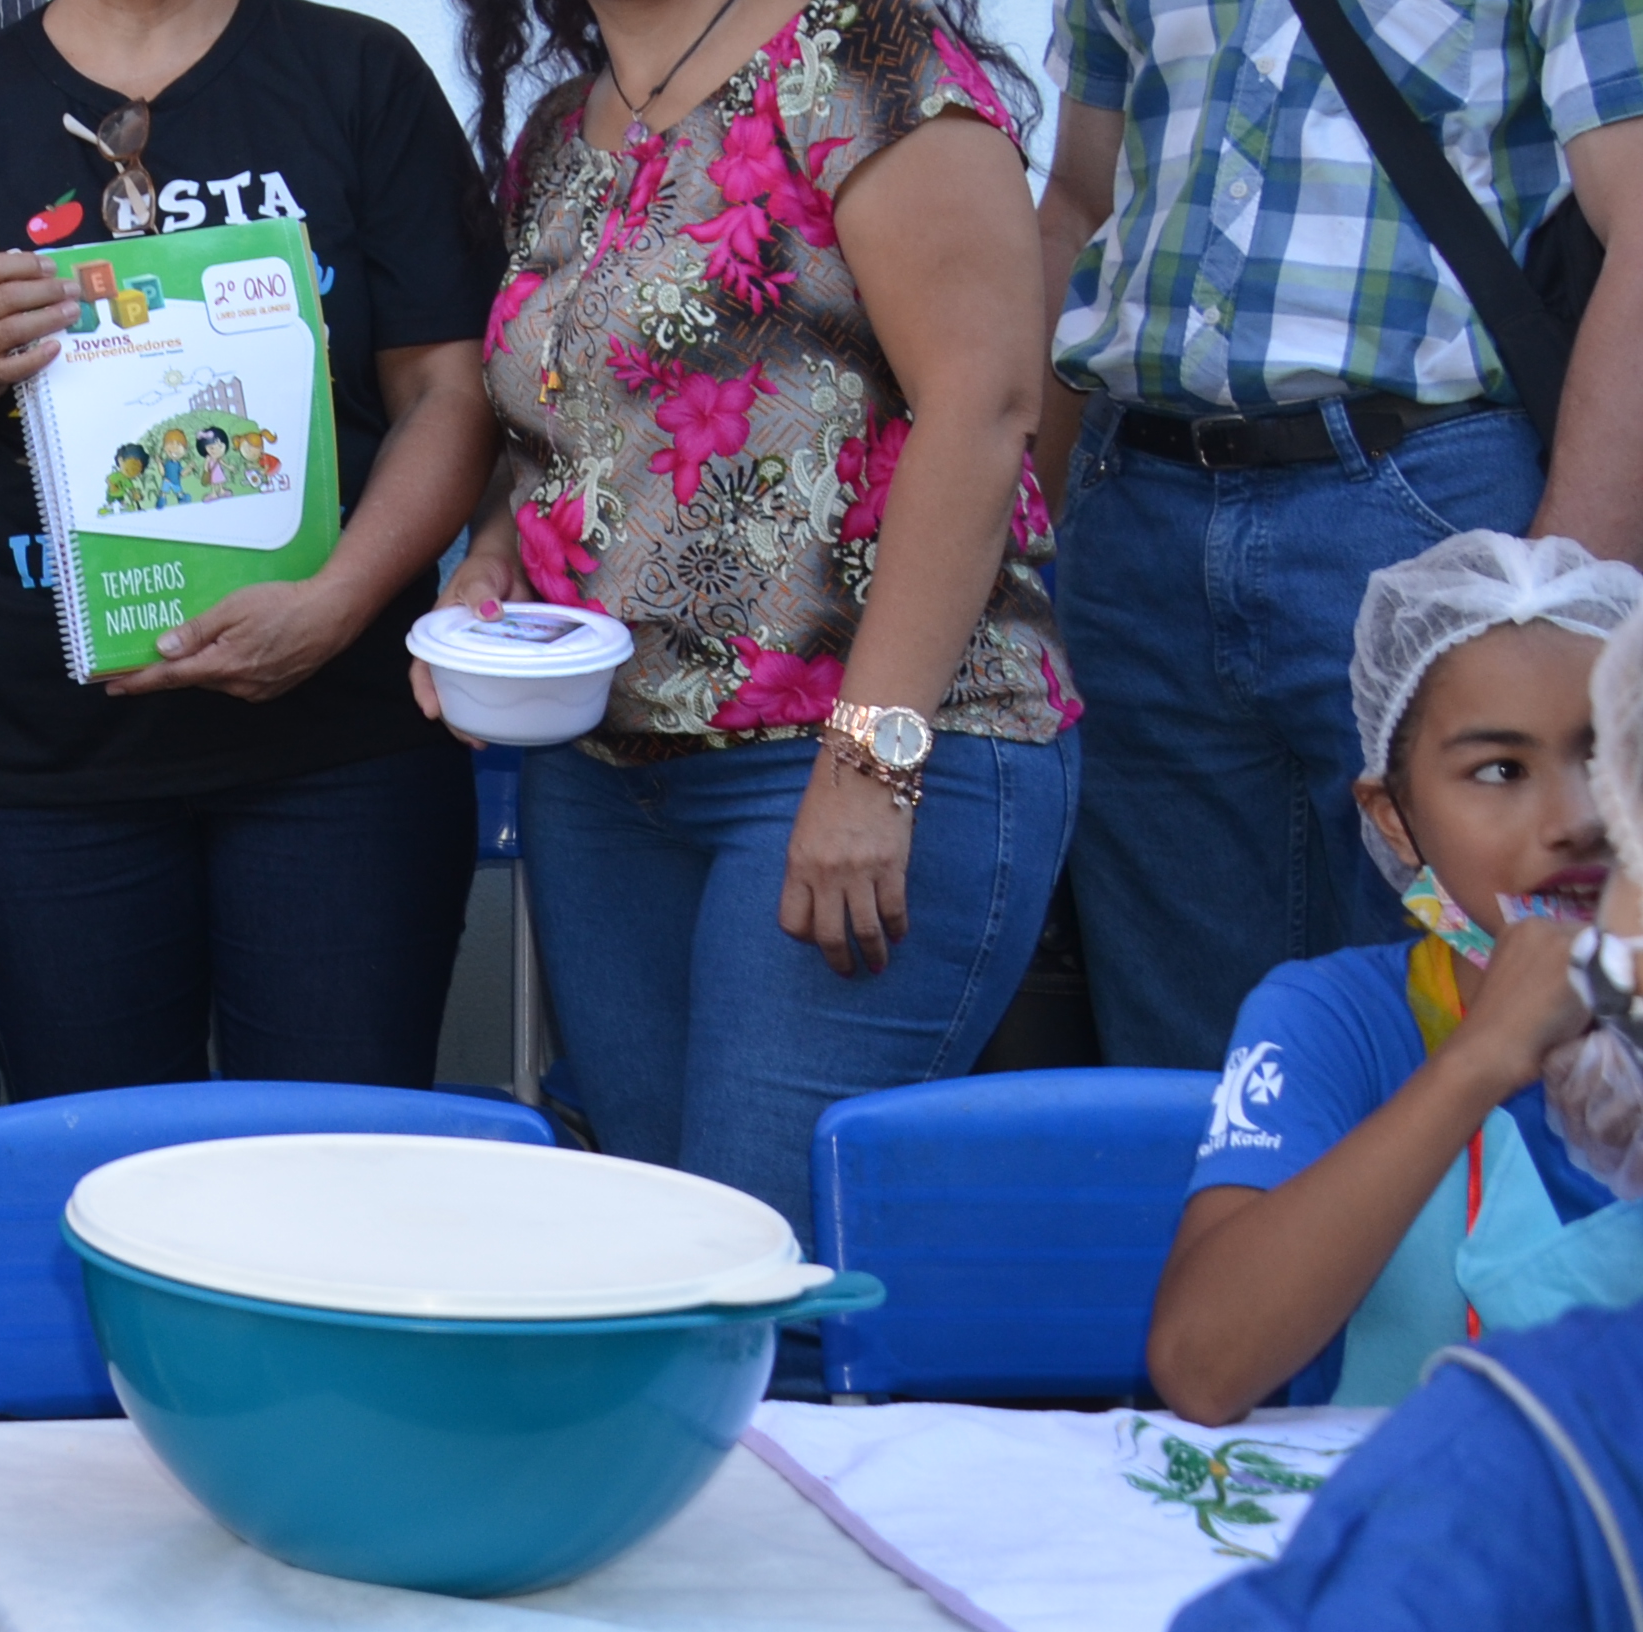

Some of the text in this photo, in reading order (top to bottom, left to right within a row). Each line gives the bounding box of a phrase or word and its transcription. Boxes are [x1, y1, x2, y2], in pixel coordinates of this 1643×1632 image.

[126, 302, 142, 323] P
[65, 338, 182, 363] Empreendedores
[71, 334, 132, 352] Jovens
[101, 561, 185, 599] TEMPEROS
[106, 598, 185, 637] NATURAIS
[1230, 1131, 1282, 1151] Kadri
